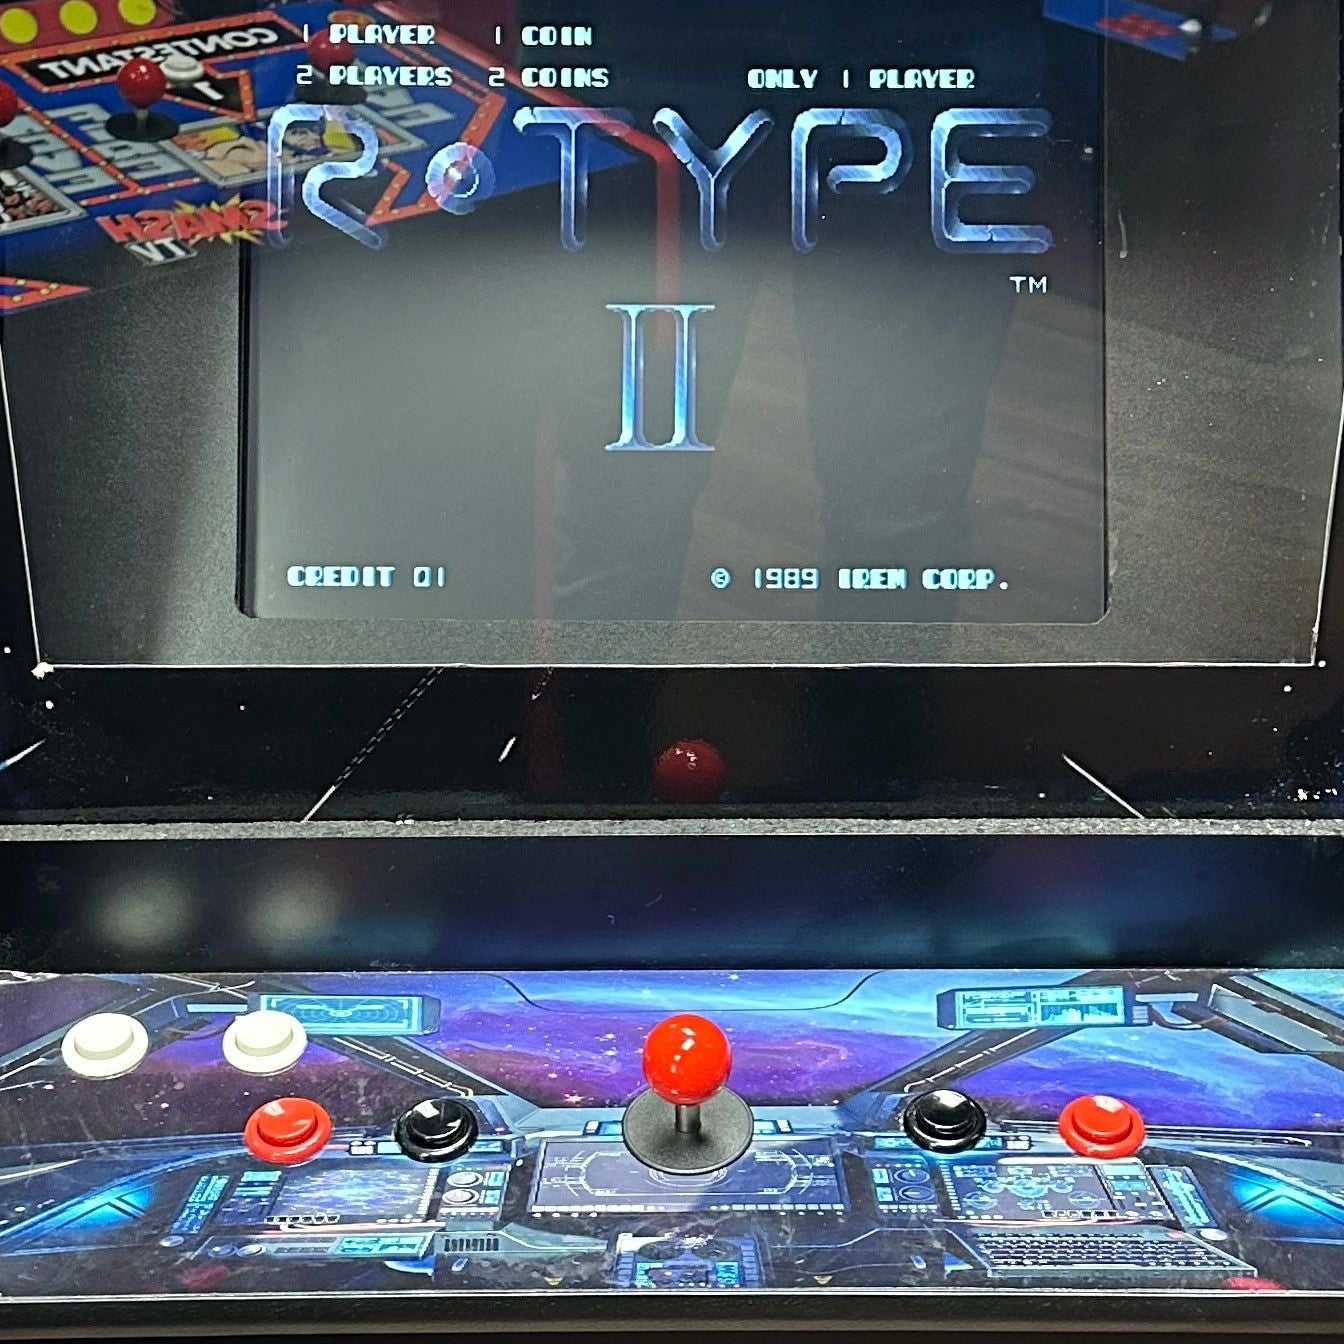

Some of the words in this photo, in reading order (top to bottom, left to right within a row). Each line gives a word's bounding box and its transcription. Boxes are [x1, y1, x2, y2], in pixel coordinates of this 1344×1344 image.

[329, 23, 436, 45] PLAYER
[521, 25, 593, 47] COIN
[295, 64, 314, 86] 2
[329, 64, 454, 87] PLAYERS
[487, 66, 506, 88] 2
[521, 66, 610, 89] COINS
[747, 68, 819, 89] ONLY
[868, 68, 976, 89] PLAYER
[1009, 275, 1047, 294] TM
[286, 565, 397, 588] CREDIT
[754, 567, 821, 590] 1989
[838, 567, 909, 590] IREM
[921, 567, 1009, 591] CORP.
